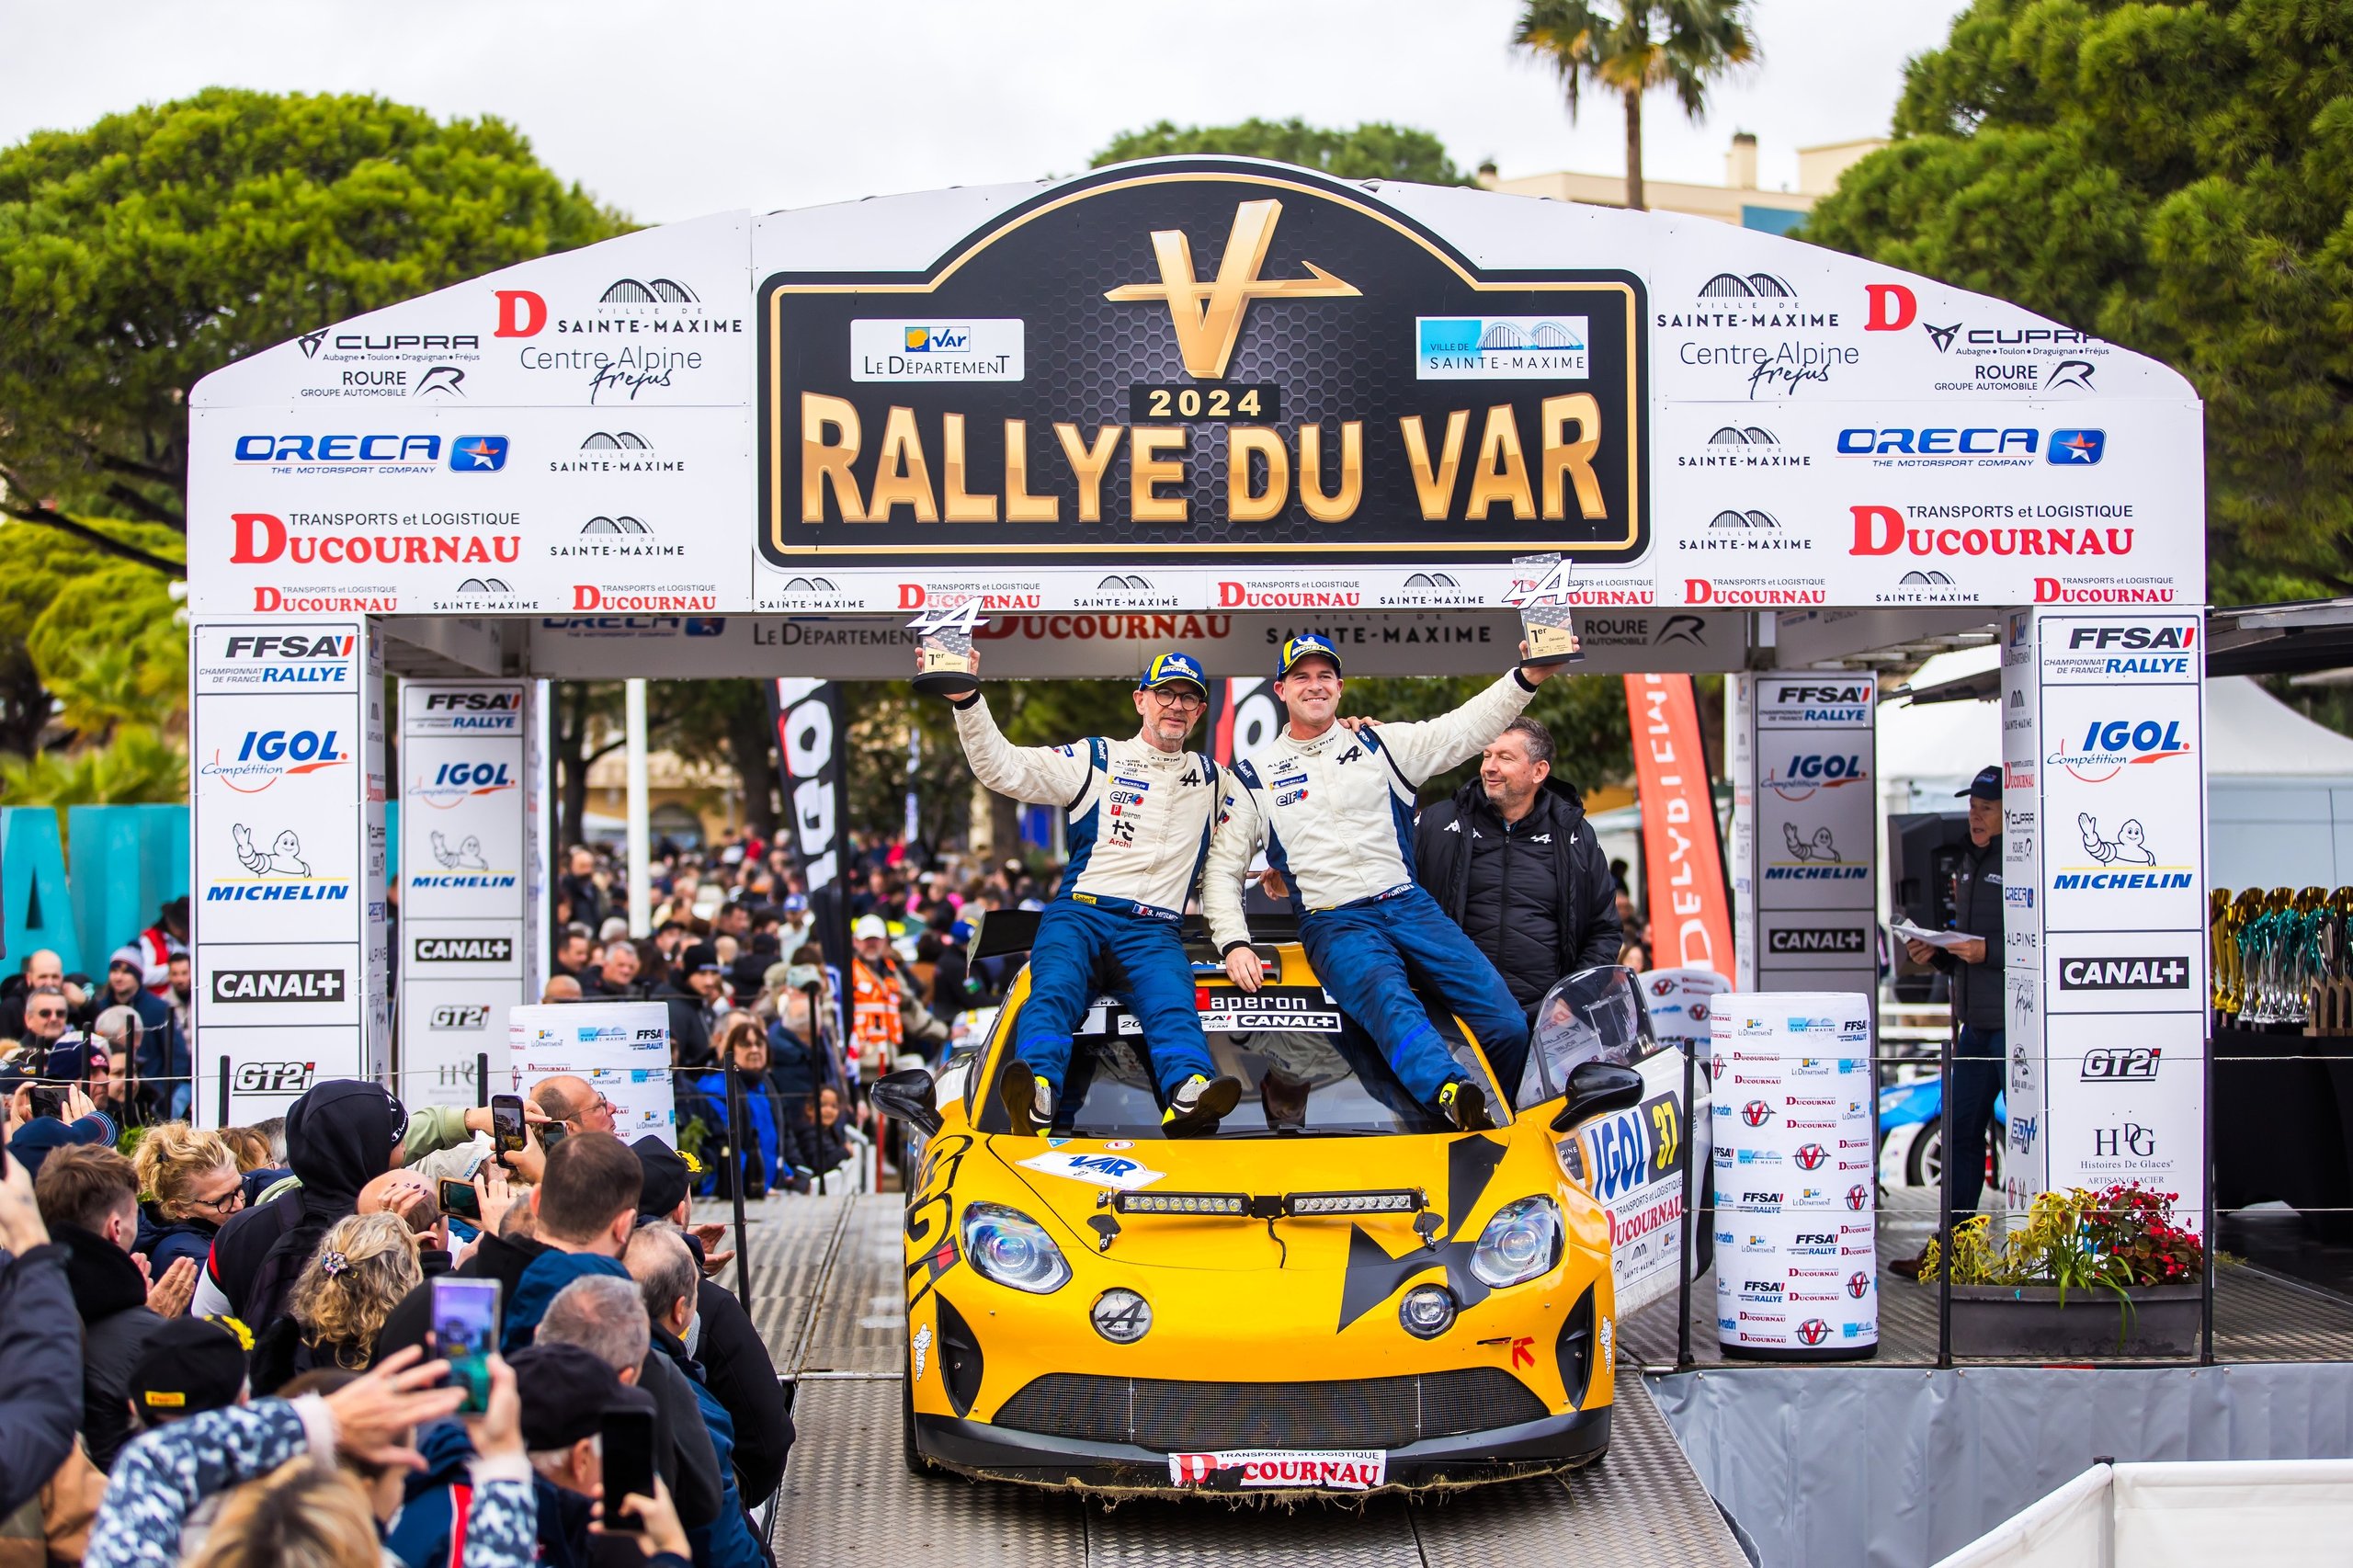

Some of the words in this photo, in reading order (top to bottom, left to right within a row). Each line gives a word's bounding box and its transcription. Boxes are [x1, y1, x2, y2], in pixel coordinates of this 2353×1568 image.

[494, 290, 547, 338] D
[1864, 284, 1917, 332] D
[558, 320, 743, 334] SAINTE-MAXIME
[1657, 313, 1839, 328] SAINTE-MAXIME
[335, 335, 479, 350] CUPRA
[323, 353, 359, 363] Aubagne
[367, 353, 394, 361] Toulon
[402, 353, 447, 363] Draguignan
[455, 352, 480, 363] Fréjus
[520, 347, 608, 369] Centre
[618, 346, 702, 371] Alpine
[1680, 342, 1768, 365] Centre
[1776, 342, 1859, 370] Alpine
[1956, 347, 1992, 358] Aubagne
[1998, 347, 2026, 356] Toulon
[2033, 347, 2078, 358] Draguignan
[2085, 347, 2109, 358] Fréjus
[1430, 357, 1586, 369] SAINTE-MAXIME
[343, 371, 406, 385] ROURE
[1975, 366, 2038, 380] ROURE
[301, 388, 340, 397] GROUPE
[344, 388, 406, 397] AUTOMOBILE
[1935, 382, 1972, 391] GROUPE
[1976, 382, 2038, 391] AUTOMOBILE
[1149, 389, 1262, 416] 2024
[235, 435, 441, 460] ORECA
[1837, 428, 2039, 454] ORECA
[801, 391, 1188, 524] RALLYE
[1228, 421, 1363, 523] DU
[1399, 392, 1608, 521] VAR
[1678, 457, 1811, 466] SAINTE-MAXIME
[551, 462, 684, 472] SAINTE-MAXIME
[1907, 506, 2014, 517] TRANSPORTS
[2018, 506, 2032, 517] et
[2037, 505, 2133, 518] LOGISTIQUE
[290, 514, 398, 526] TRANSPORTS
[403, 515, 418, 526] et
[423, 513, 520, 527] LOGISTIQUE
[230, 513, 521, 564] DUCOURNAU
[1849, 506, 2134, 556] DUCOURNAU
[551, 546, 685, 556] SAINTE-MAXIME
[991, 583, 1040, 591] LOGISTIQUE
[1310, 581, 1359, 589] LOGISTIQUE
[2124, 576, 2174, 585] LOGISTIQUE
[347, 585, 397, 594] LOGISTIQUE
[897, 584, 1040, 609] DUCORNAU
[1219, 582, 1360, 608] DUCOURNAU
[1684, 579, 1825, 605] DUCOURNAU
[2033, 577, 2174, 603] DUCOURNAU
[254, 586, 397, 612] DUCOURNAU
[433, 601, 539, 610] SAINTE-MAXIME
[573, 585, 716, 611] DUCOURNAU
[760, 600, 865, 608] SAINTE-MAXIME
[781, 622, 919, 646] DÉPARTEMEN
[1585, 620, 1648, 634] ROURE
[1586, 637, 1648, 645] AUTOMOBILE
[2069, 628, 2178, 649] FFSA
[225, 636, 337, 658] FFSA
[2044, 659, 2106, 667] CHAMPIONNAT
[2106, 658, 2188, 674] RALLYE
[262, 667, 347, 682] RALLYE
[426, 694, 511, 710] FFSA
[1778, 687, 1859, 703] FFSA
[453, 717, 516, 728] RALLYE
[1804, 710, 1865, 722] RALLYE
[2047, 753, 2127, 768] Compétition
[201, 763, 283, 778] Compétition
[1110, 791, 1131, 804] elf
[1276, 790, 1296, 806] elf
[1109, 838, 1131, 848] Archi
[412, 876, 516, 887] MICHELIN
[1765, 868, 1868, 880] MICHELIN
[2053, 873, 2192, 890] MICHELIN
[206, 885, 349, 902] MICHELIN
[1772, 931, 1862, 949] CANAL+
[2006, 933, 2036, 948] ALPINE
[418, 941, 508, 959] CANAL+
[2064, 961, 2185, 985] CANAL+
[217, 973, 340, 997] CANAL+
[1241, 1016, 1336, 1028] CANAL+
[1735, 1075, 1781, 1085] DUCOURNAU
[1786, 1096, 1836, 1106] DUCOURNAU
[1653, 1101, 1677, 1170] 37
[1590, 1111, 1646, 1201] IGOL
[1068, 1155, 1137, 1177] VAR
[2081, 1160, 2121, 1169] Histoires
[2125, 1160, 2137, 1168] De
[2087, 1176, 2125, 1185] ARTISAN
[2127, 1176, 2165, 1185] GLACIER
[1616, 1194, 1648, 1217] TRANSPORTS
[1654, 1177, 1682, 1199] LOGISTIQUE
[1740, 1312, 1785, 1322] DUCOURNAU
[1176, 1454, 1379, 1484] DCOURNAU
